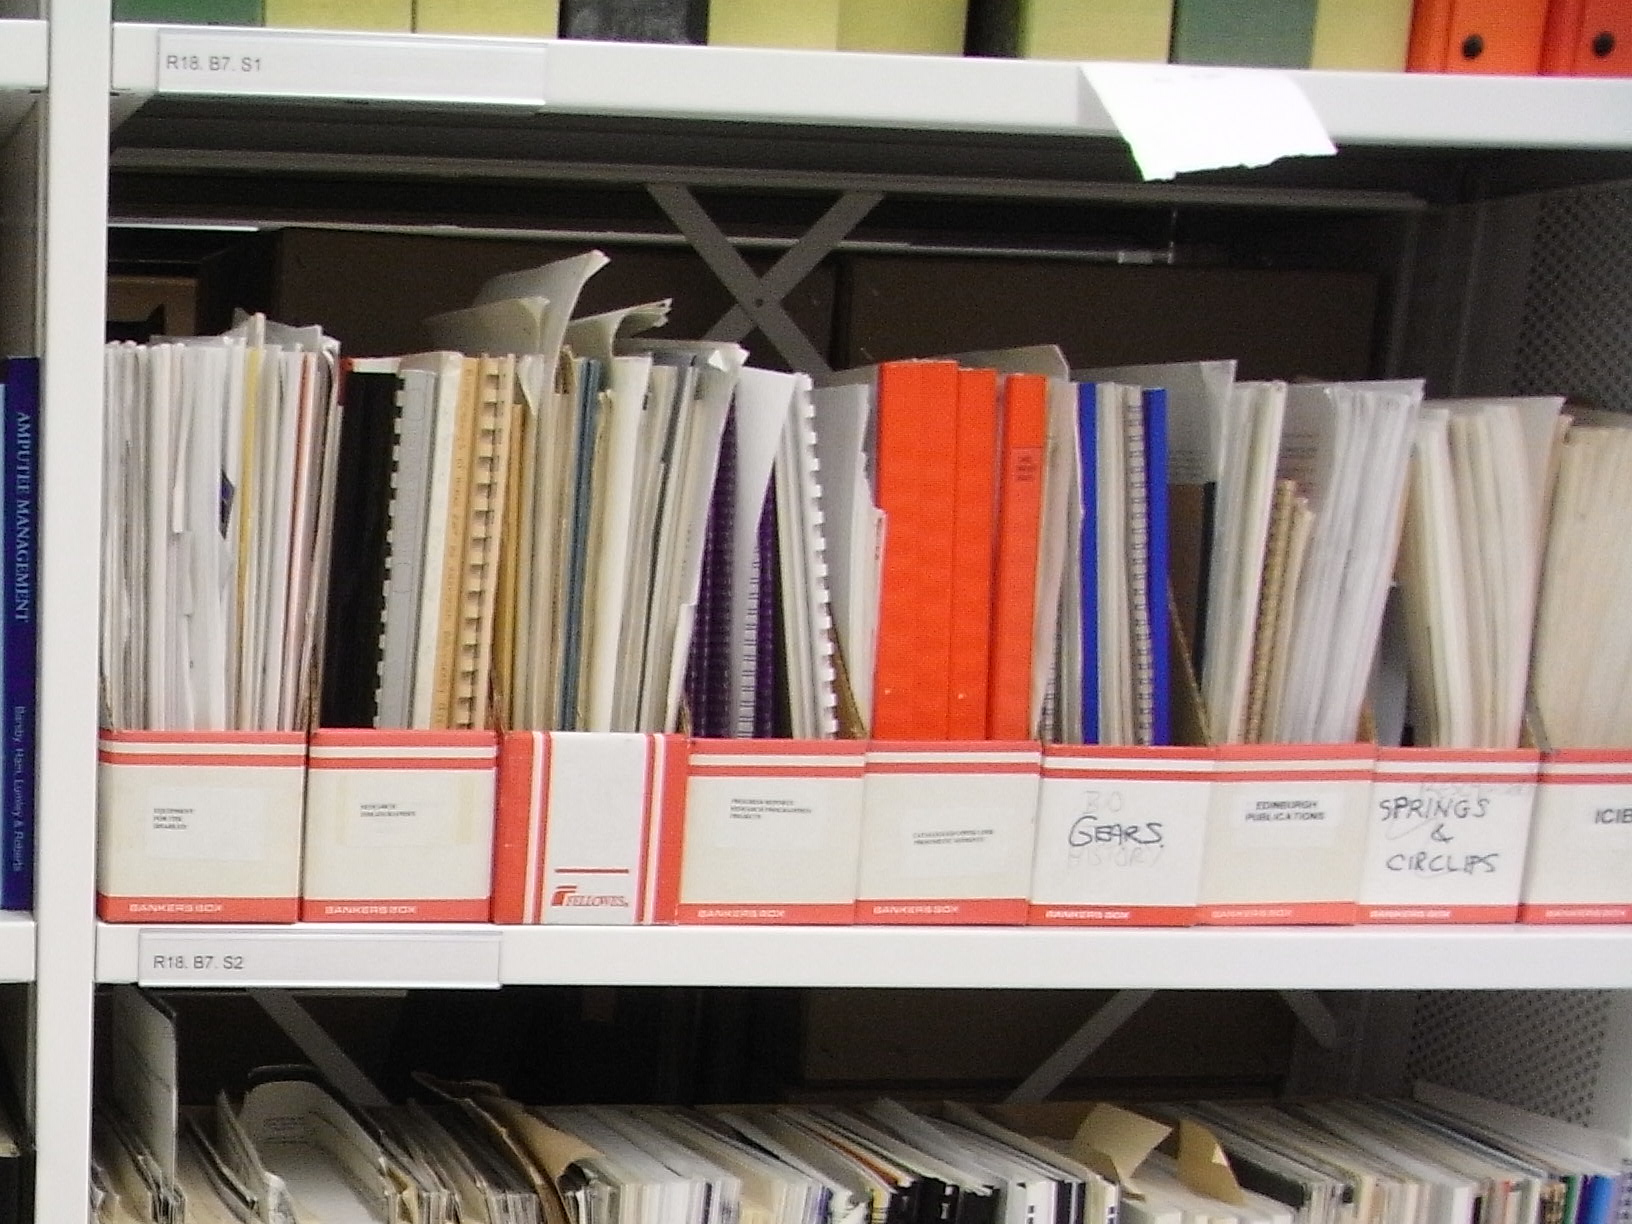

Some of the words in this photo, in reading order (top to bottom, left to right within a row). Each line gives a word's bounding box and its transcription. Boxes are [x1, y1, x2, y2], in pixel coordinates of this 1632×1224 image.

[166, 55, 203, 71] R18.
[209, 56, 235, 72] B7.
[241, 56, 262, 72] S1
[15, 412, 31, 495] AMPUTEE
[13, 499, 30, 625] MANAGEMENT
[1255, 800, 1318, 810] EDINBURGH
[1378, 796, 1491, 822] SPRINGS
[1244, 811, 1325, 822] PUBLICATIONS
[1431, 823, 1455, 843] &
[1385, 852, 1500, 874] CIRCLIPS
[128, 903, 194, 913] BANKERS
[195, 903, 223, 913] BOX
[324, 906, 388, 914] BANKERS
[389, 906, 417, 914] BOX
[697, 909, 758, 918] BANKERS
[873, 905, 933, 914] BANKERS
[1045, 910, 1103, 920] BANKERS
[153, 955, 188, 971] R18.
[223, 955, 244, 971] S2
